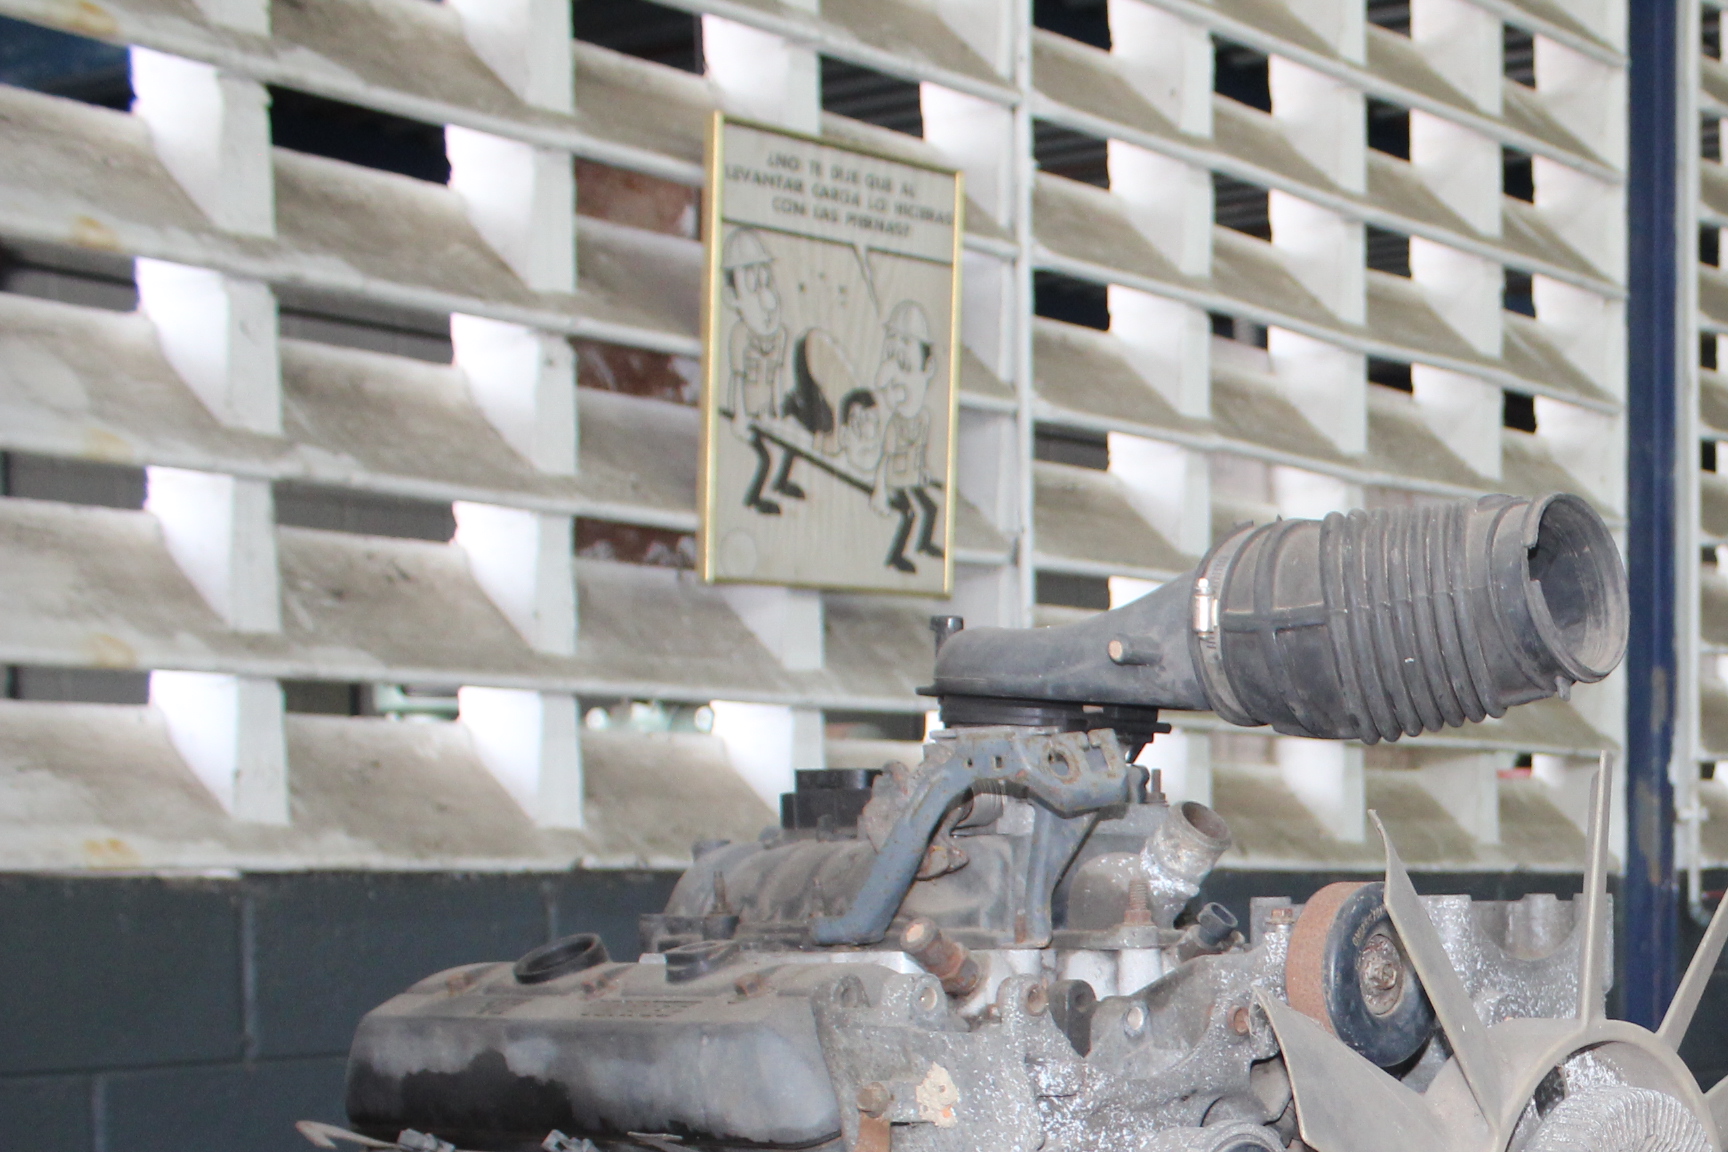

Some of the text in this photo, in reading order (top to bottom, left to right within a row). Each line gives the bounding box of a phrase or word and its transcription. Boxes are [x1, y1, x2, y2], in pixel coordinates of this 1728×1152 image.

[724, 164, 804, 193] LEVANTAR
[811, 182, 861, 208] CARGA
[868, 193, 887, 212] LO
[809, 159, 822, 177] TE
[864, 172, 893, 193] QUE
[900, 181, 916, 198] AL
[771, 195, 808, 216] CON
[813, 204, 839, 224] LAS
